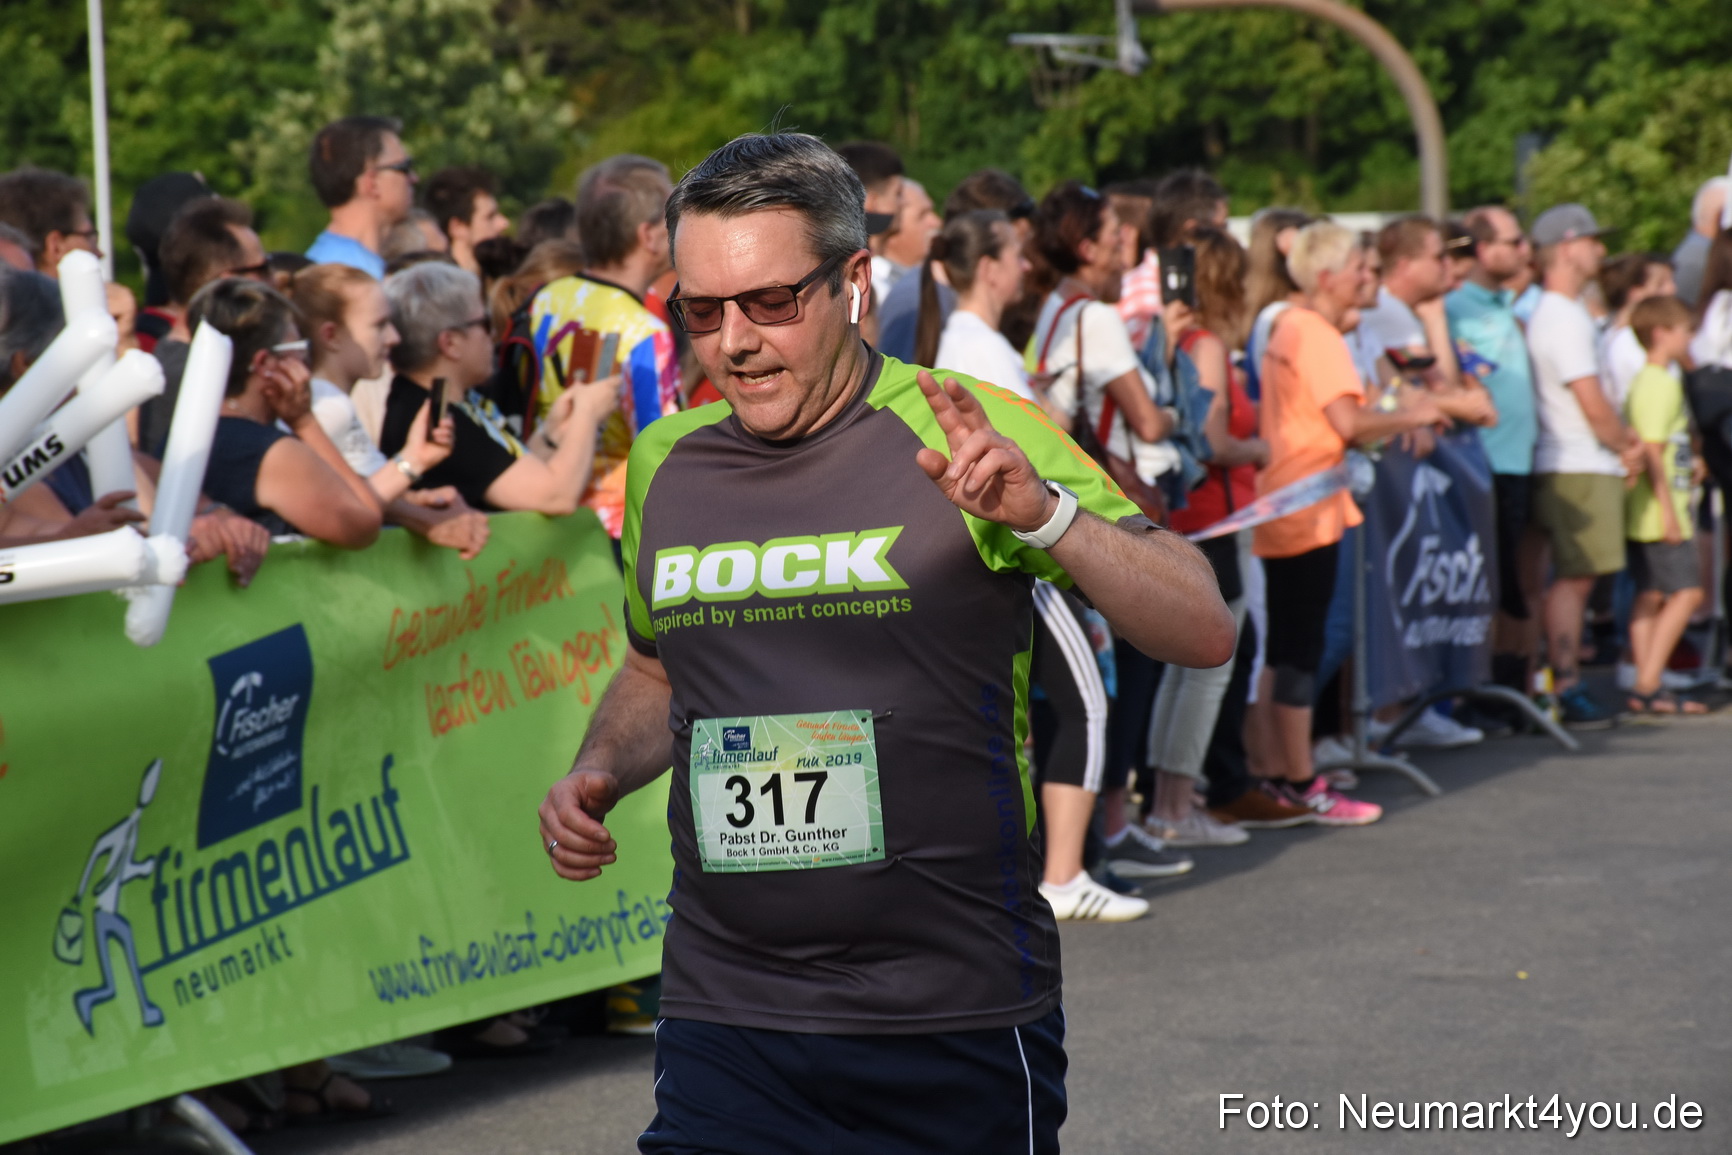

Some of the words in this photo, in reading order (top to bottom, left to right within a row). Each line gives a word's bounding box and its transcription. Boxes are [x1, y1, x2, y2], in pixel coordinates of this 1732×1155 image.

[653, 535, 892, 603] BOCK
[653, 609, 705, 635] inspired
[711, 606, 736, 628] by
[743, 602, 806, 623] smart
[811, 595, 912, 618] concepts
[425, 652, 517, 738] laufen
[509, 602, 621, 706] länger!
[228, 692, 300, 744] Fischer
[796, 719, 830, 730] Gesunde
[832, 721, 861, 731] Firmen
[811, 730, 836, 742] laufen
[713, 746, 779, 763] firmenlauf
[796, 756, 819, 769] run
[825, 752, 862, 767] 2019
[724, 770, 828, 828] 317
[152, 753, 410, 964] firmenlauf
[720, 832, 756, 846] Pabst
[760, 831, 781, 844] Dr.
[785, 828, 848, 843] Gunther
[726, 848, 749, 858] Bock
[752, 847, 756, 856] 1
[759, 846, 789, 856] GmbH
[792, 845, 800, 855] &
[802, 844, 820, 854] Co.
[823, 842, 840, 852] KG
[173, 924, 293, 1007] neumarkt
